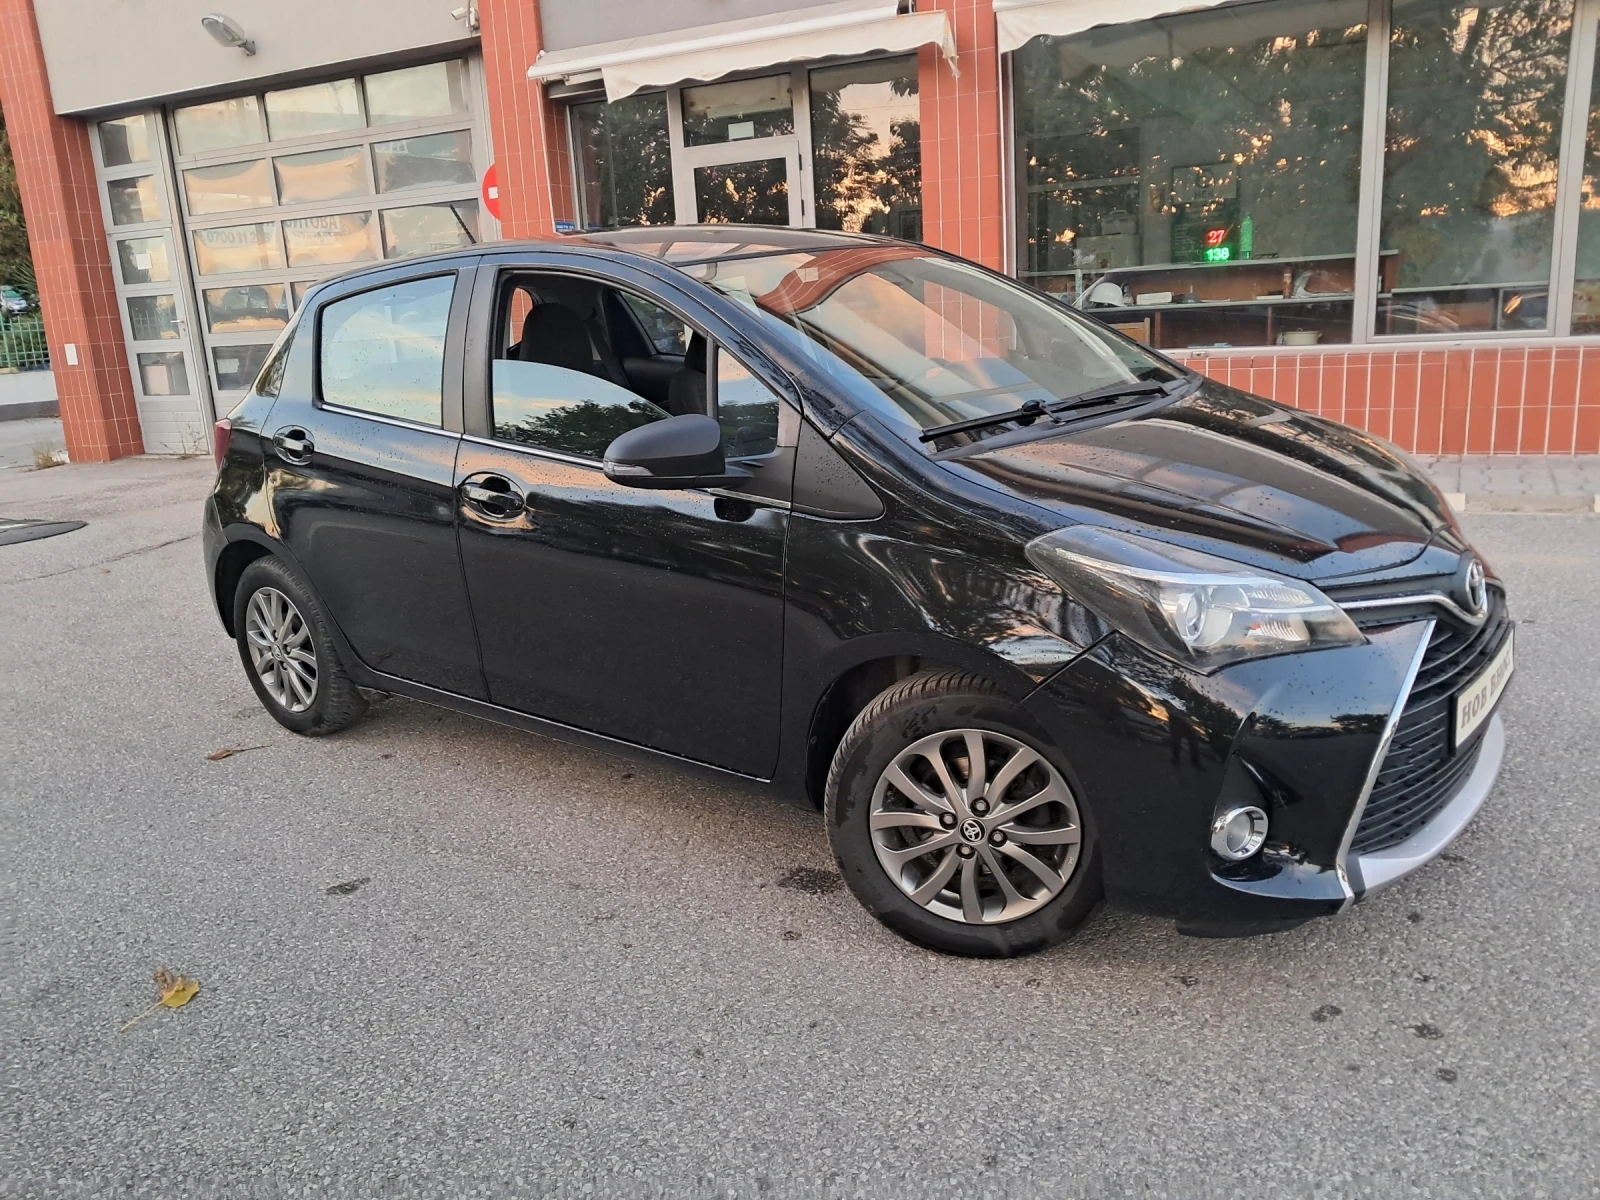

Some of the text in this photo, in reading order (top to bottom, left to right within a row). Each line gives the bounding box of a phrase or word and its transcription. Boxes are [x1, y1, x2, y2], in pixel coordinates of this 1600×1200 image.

[207, 230, 270, 244] 0700 11 26
[1208, 229, 1225, 243] 27
[1460, 685, 1488, 729] НОВ
